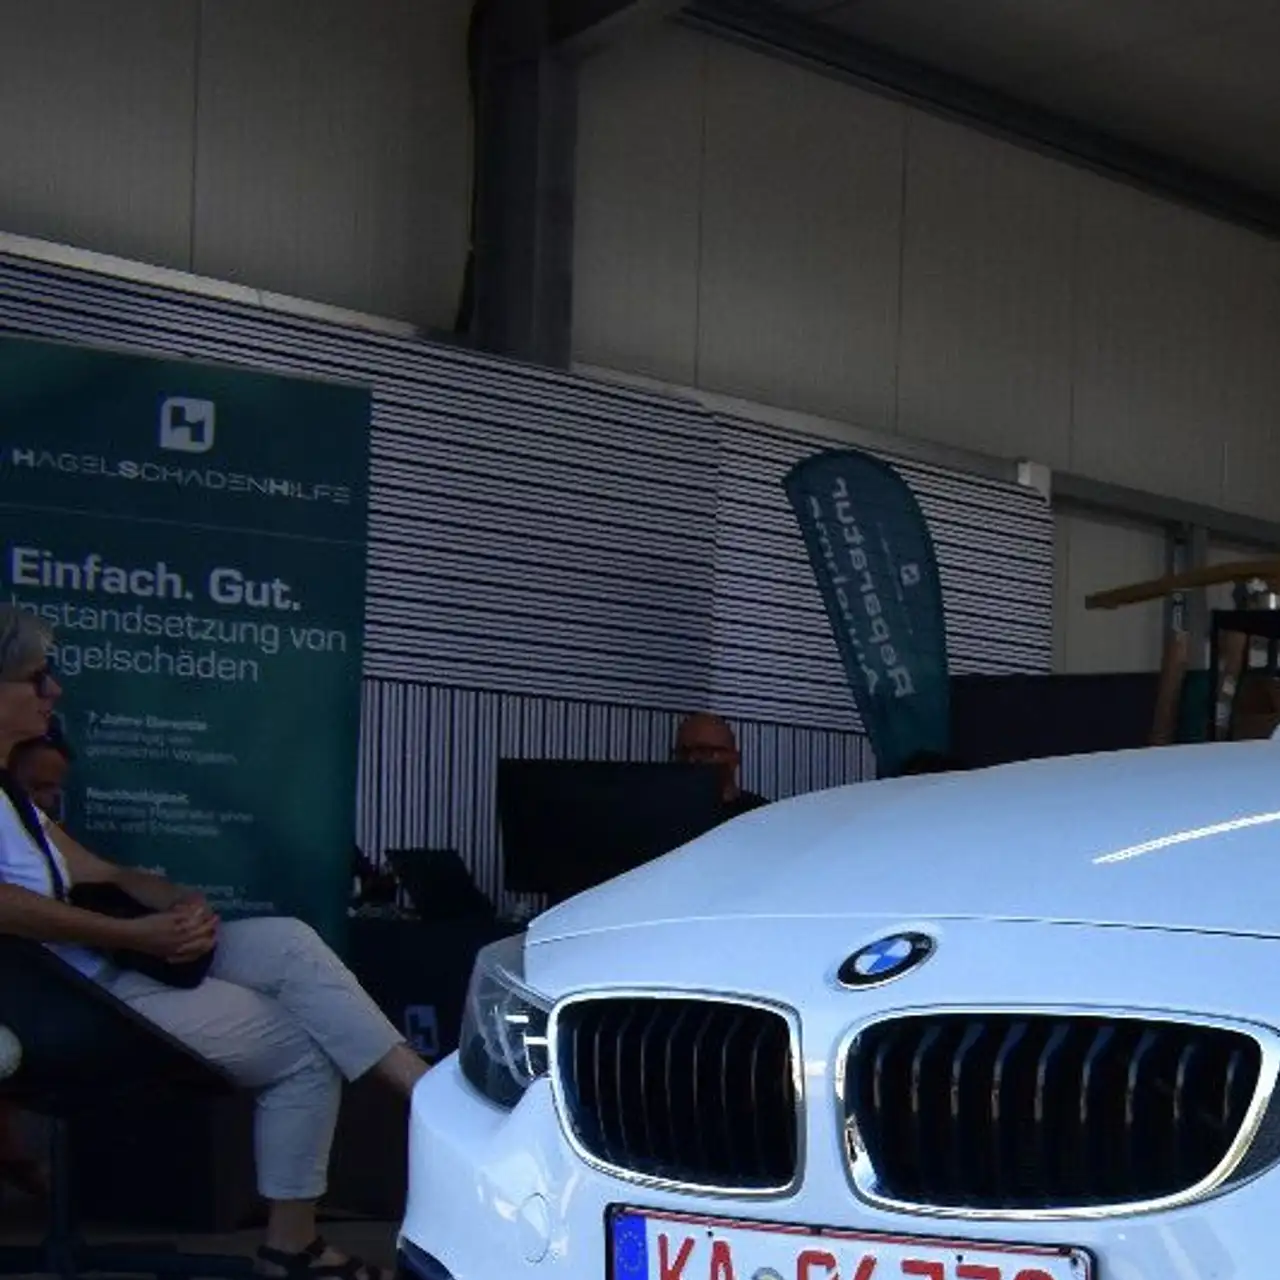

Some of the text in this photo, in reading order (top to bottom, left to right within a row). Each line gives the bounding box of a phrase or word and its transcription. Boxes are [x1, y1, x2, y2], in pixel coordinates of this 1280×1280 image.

[12, 448, 350, 503] HAGELSCHADENHILFE
[11, 545, 301, 611] Einfach. Gut.
[44, 640, 259, 683] agelschäden
[290, 625, 347, 652] von
